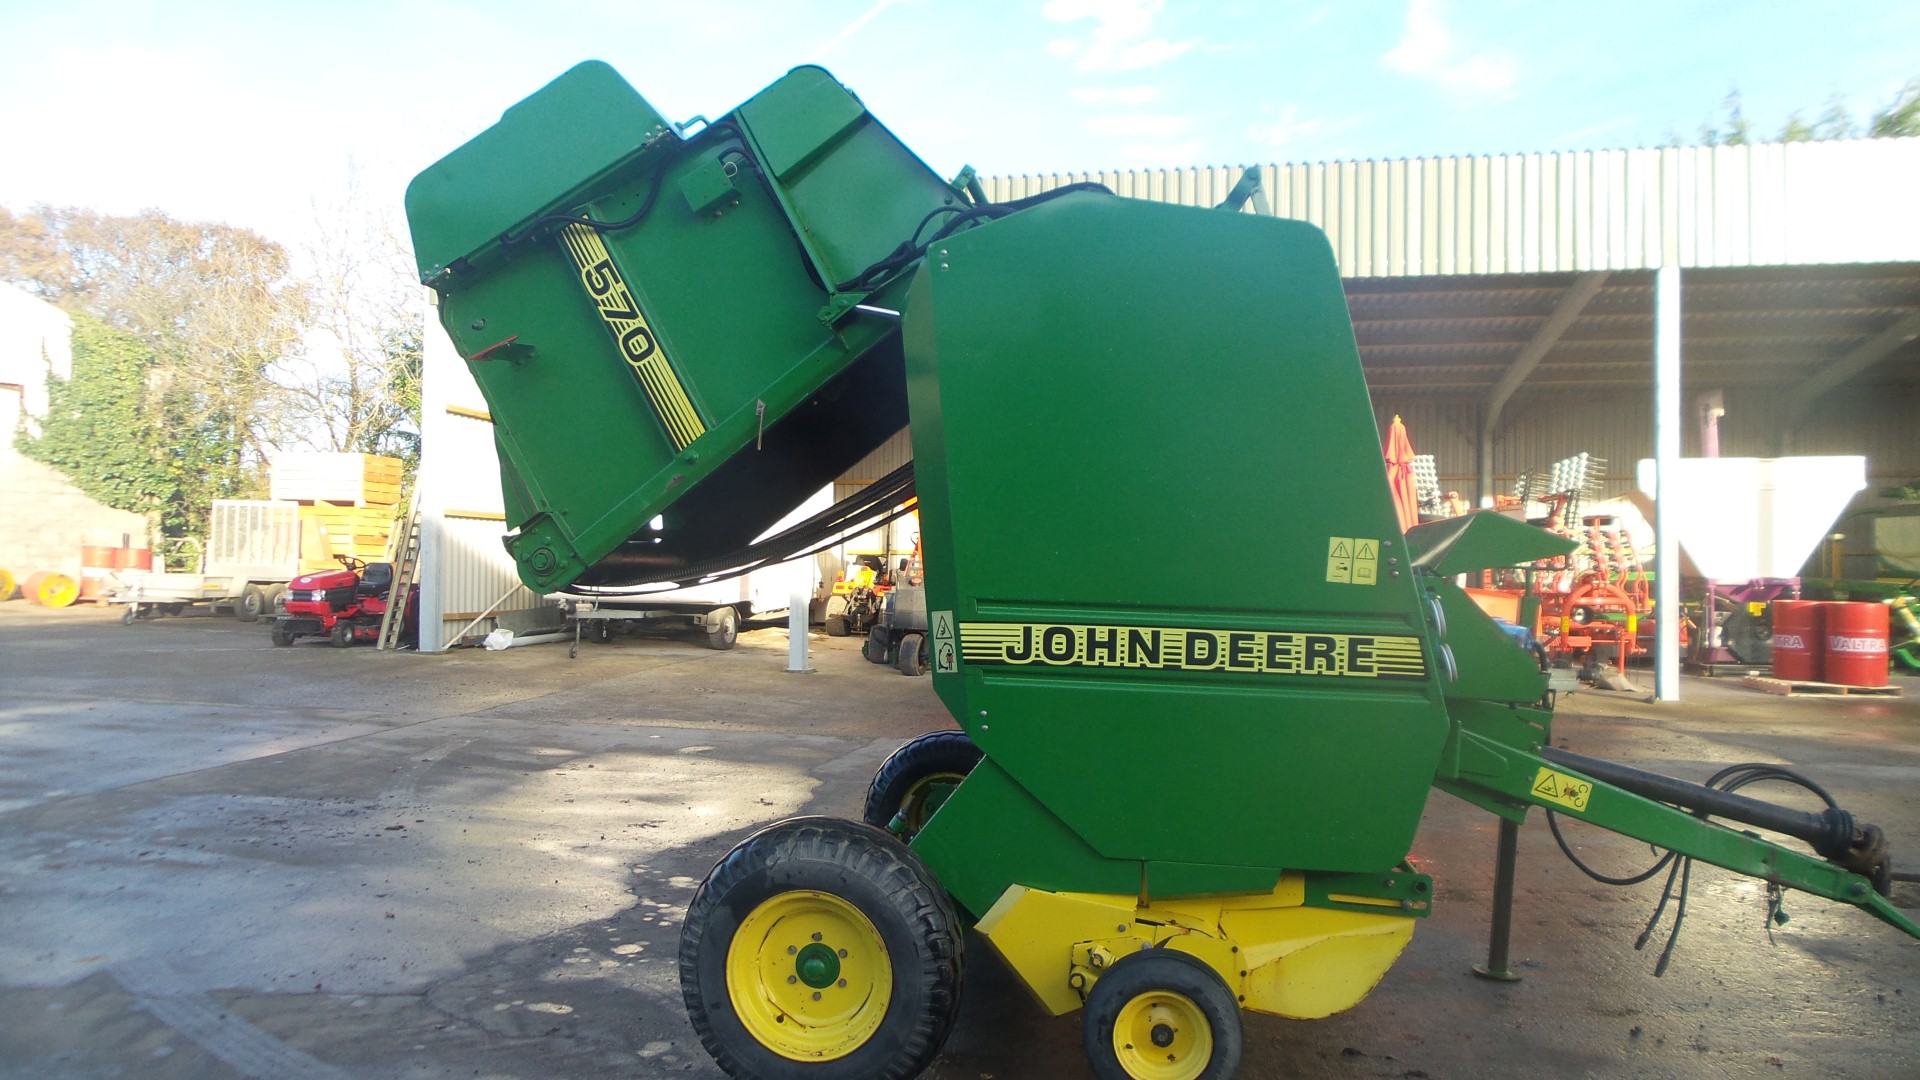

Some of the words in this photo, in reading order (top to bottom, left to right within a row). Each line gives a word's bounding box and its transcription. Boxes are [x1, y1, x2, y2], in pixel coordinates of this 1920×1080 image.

[582, 258, 655, 365] 570
[1003, 625, 1162, 666] JOHN
[1183, 631, 1376, 675] DEERE
